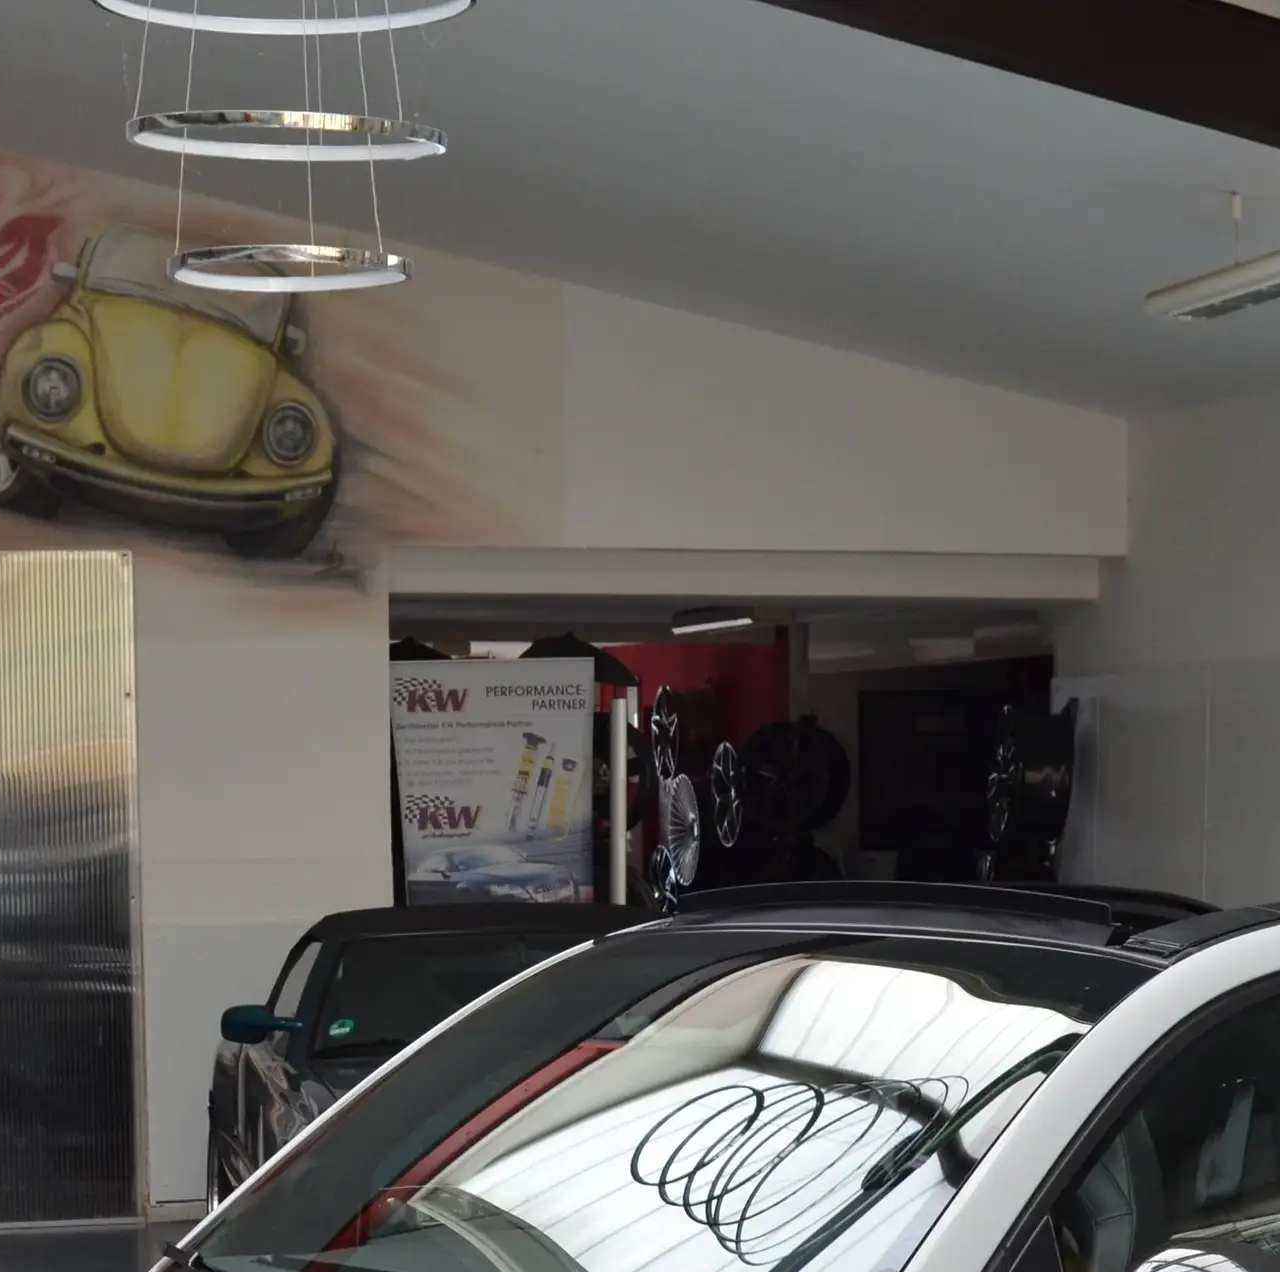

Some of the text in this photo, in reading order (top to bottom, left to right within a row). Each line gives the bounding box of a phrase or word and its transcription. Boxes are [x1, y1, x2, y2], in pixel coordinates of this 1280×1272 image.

[407, 688, 468, 713] KW
[485, 684, 587, 698] PERFORMANCE-
[532, 699, 586, 711] PARTNER
[417, 804, 482, 830] KW
